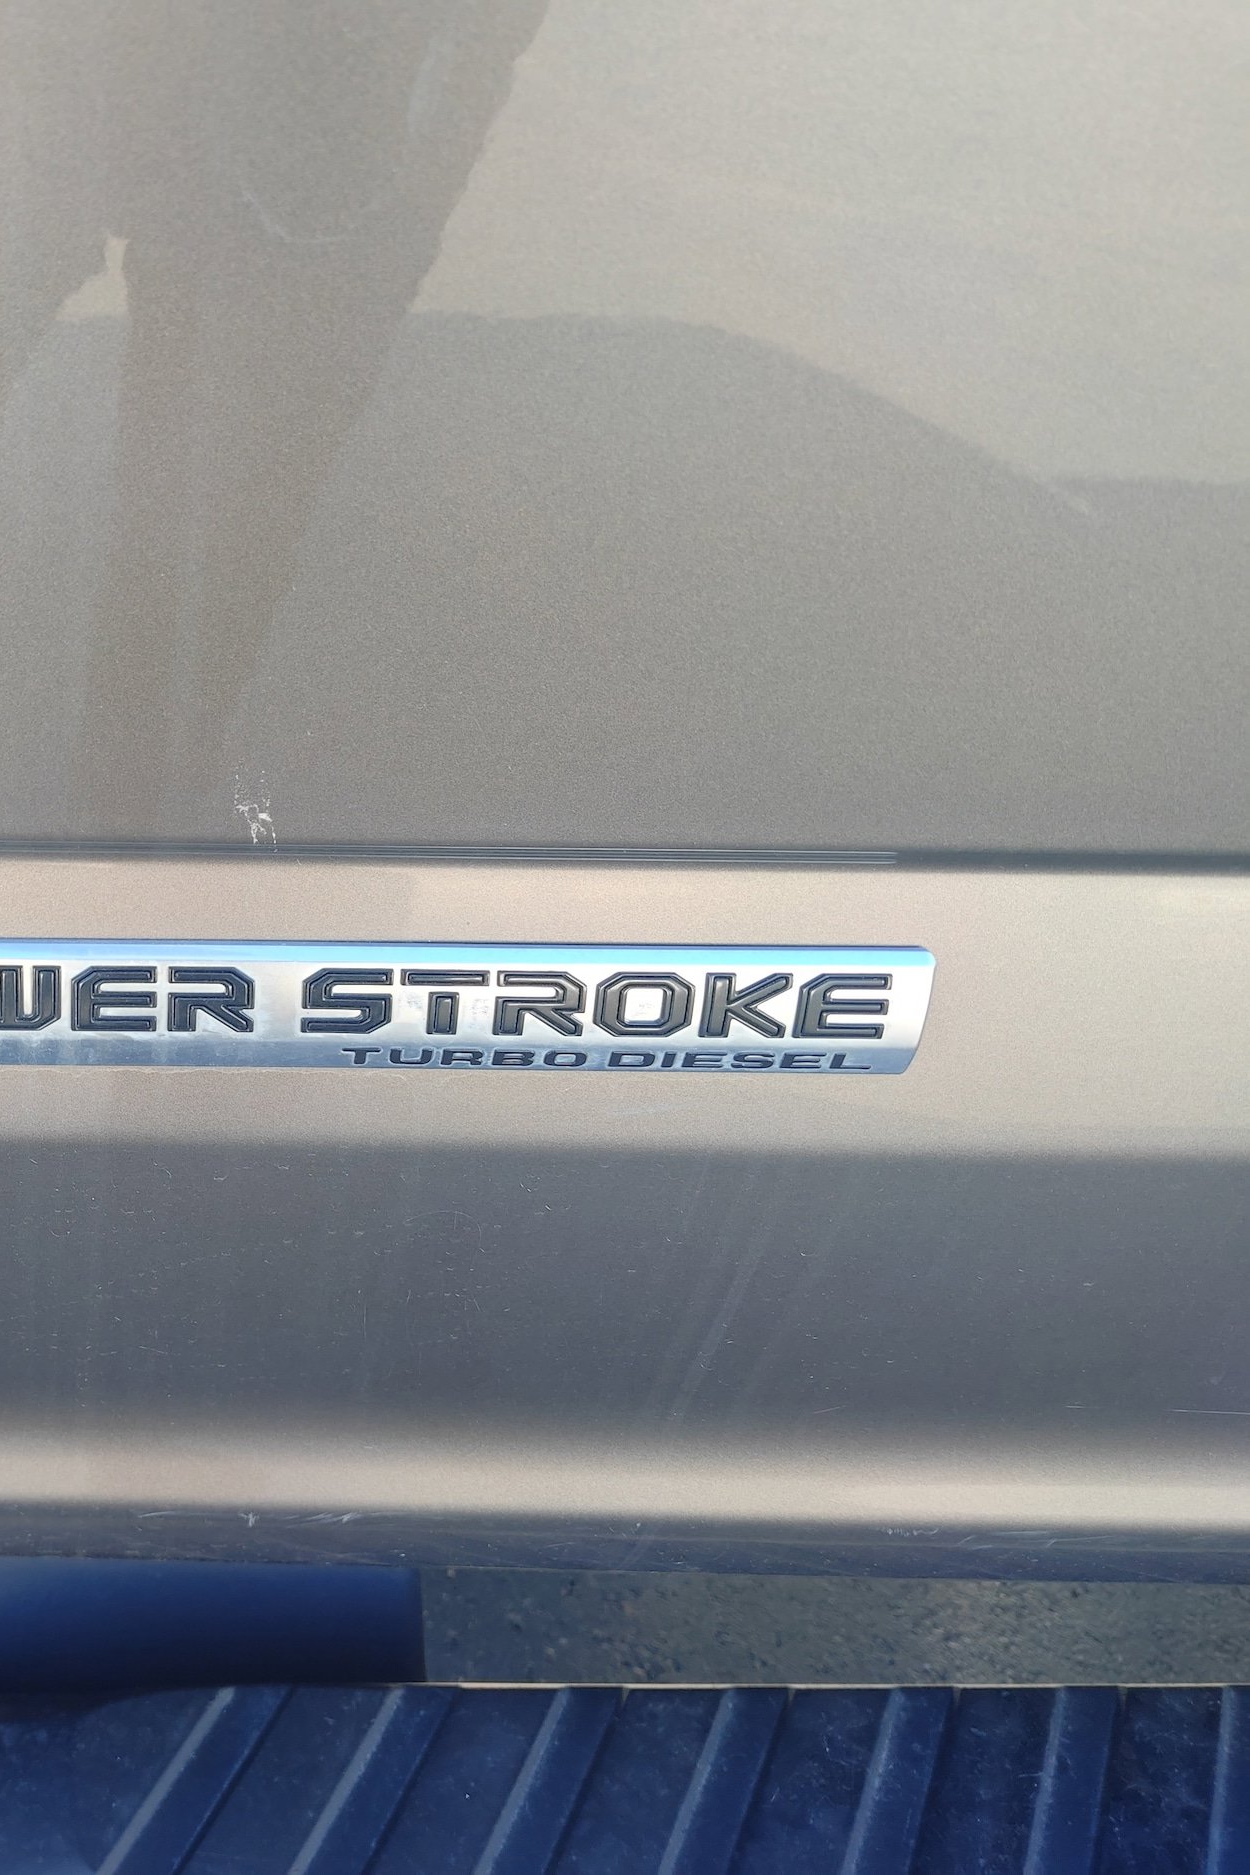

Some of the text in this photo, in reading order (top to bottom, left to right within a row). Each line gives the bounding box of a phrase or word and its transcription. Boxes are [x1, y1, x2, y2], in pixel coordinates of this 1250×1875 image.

[300, 967, 893, 1039] STROKE
[342, 1047, 872, 1071] TURBO DIESEL
